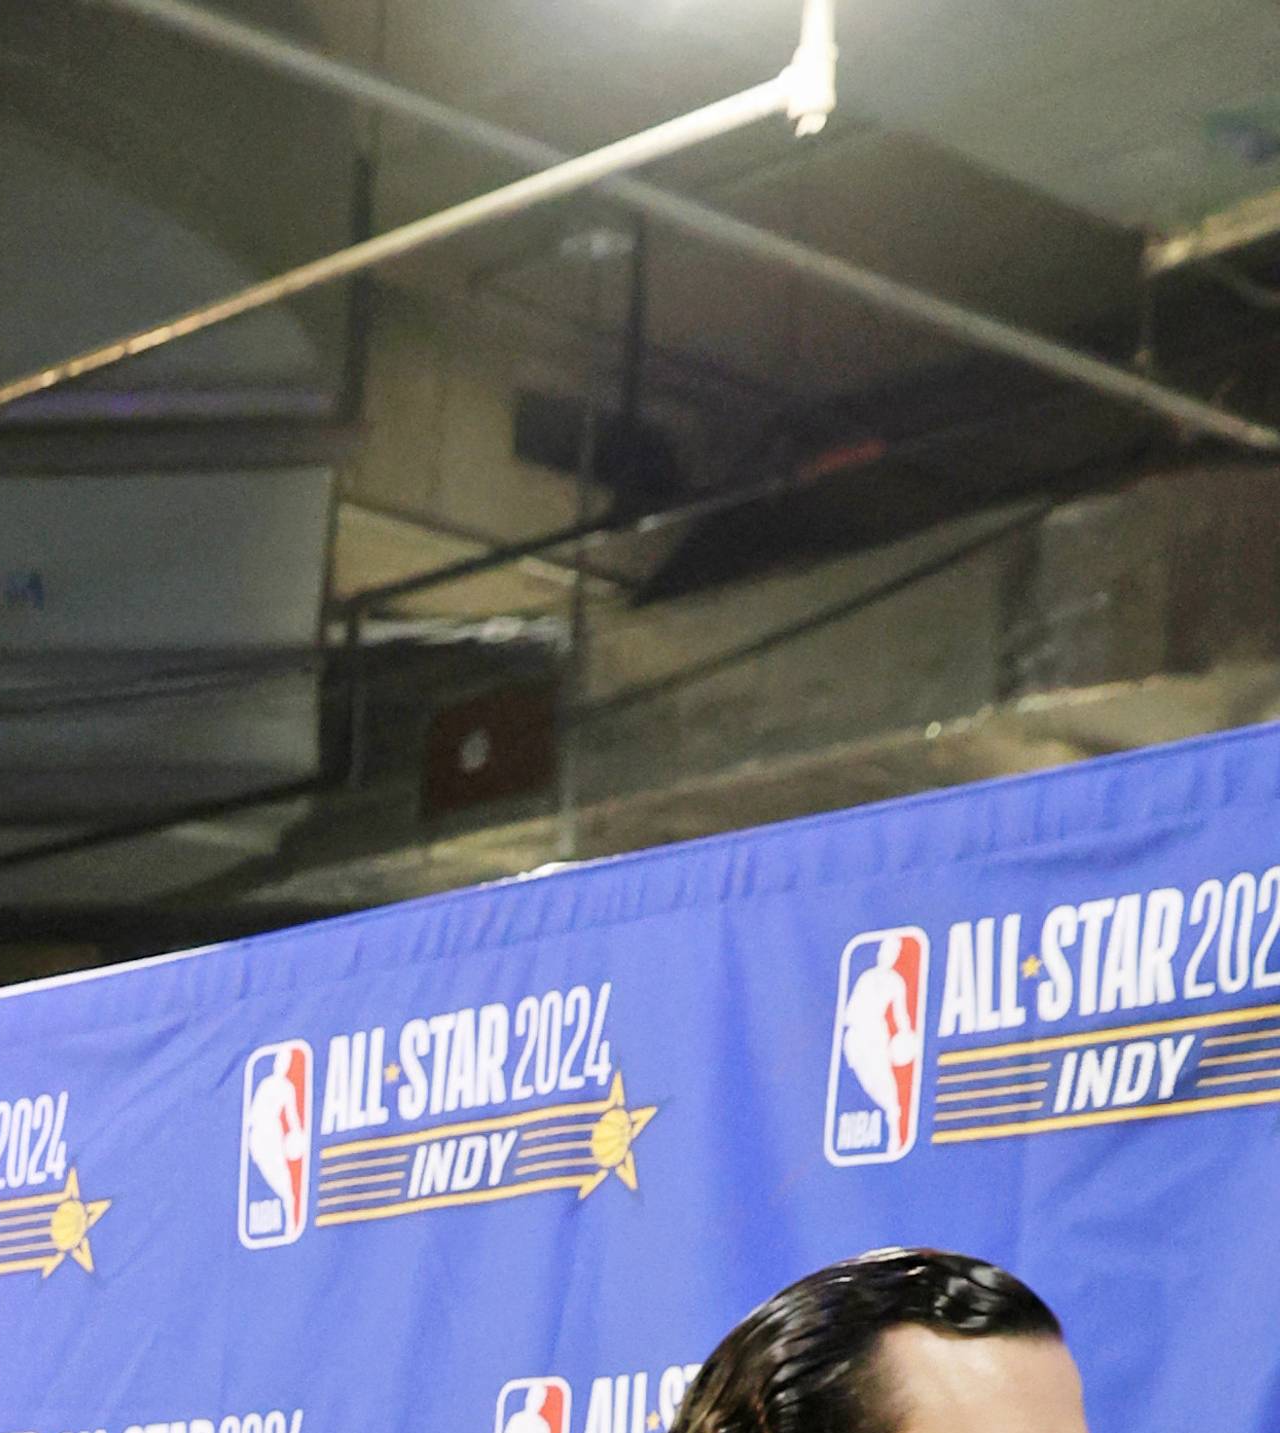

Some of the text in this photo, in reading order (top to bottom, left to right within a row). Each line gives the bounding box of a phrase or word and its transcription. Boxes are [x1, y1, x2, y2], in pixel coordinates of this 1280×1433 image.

[1183, 864, 1280, 1001] 202
[511, 981, 612, 1101] 2024
[1053, 1034, 1195, 1114] INDY
[407, 1128, 518, 1199] INDY
